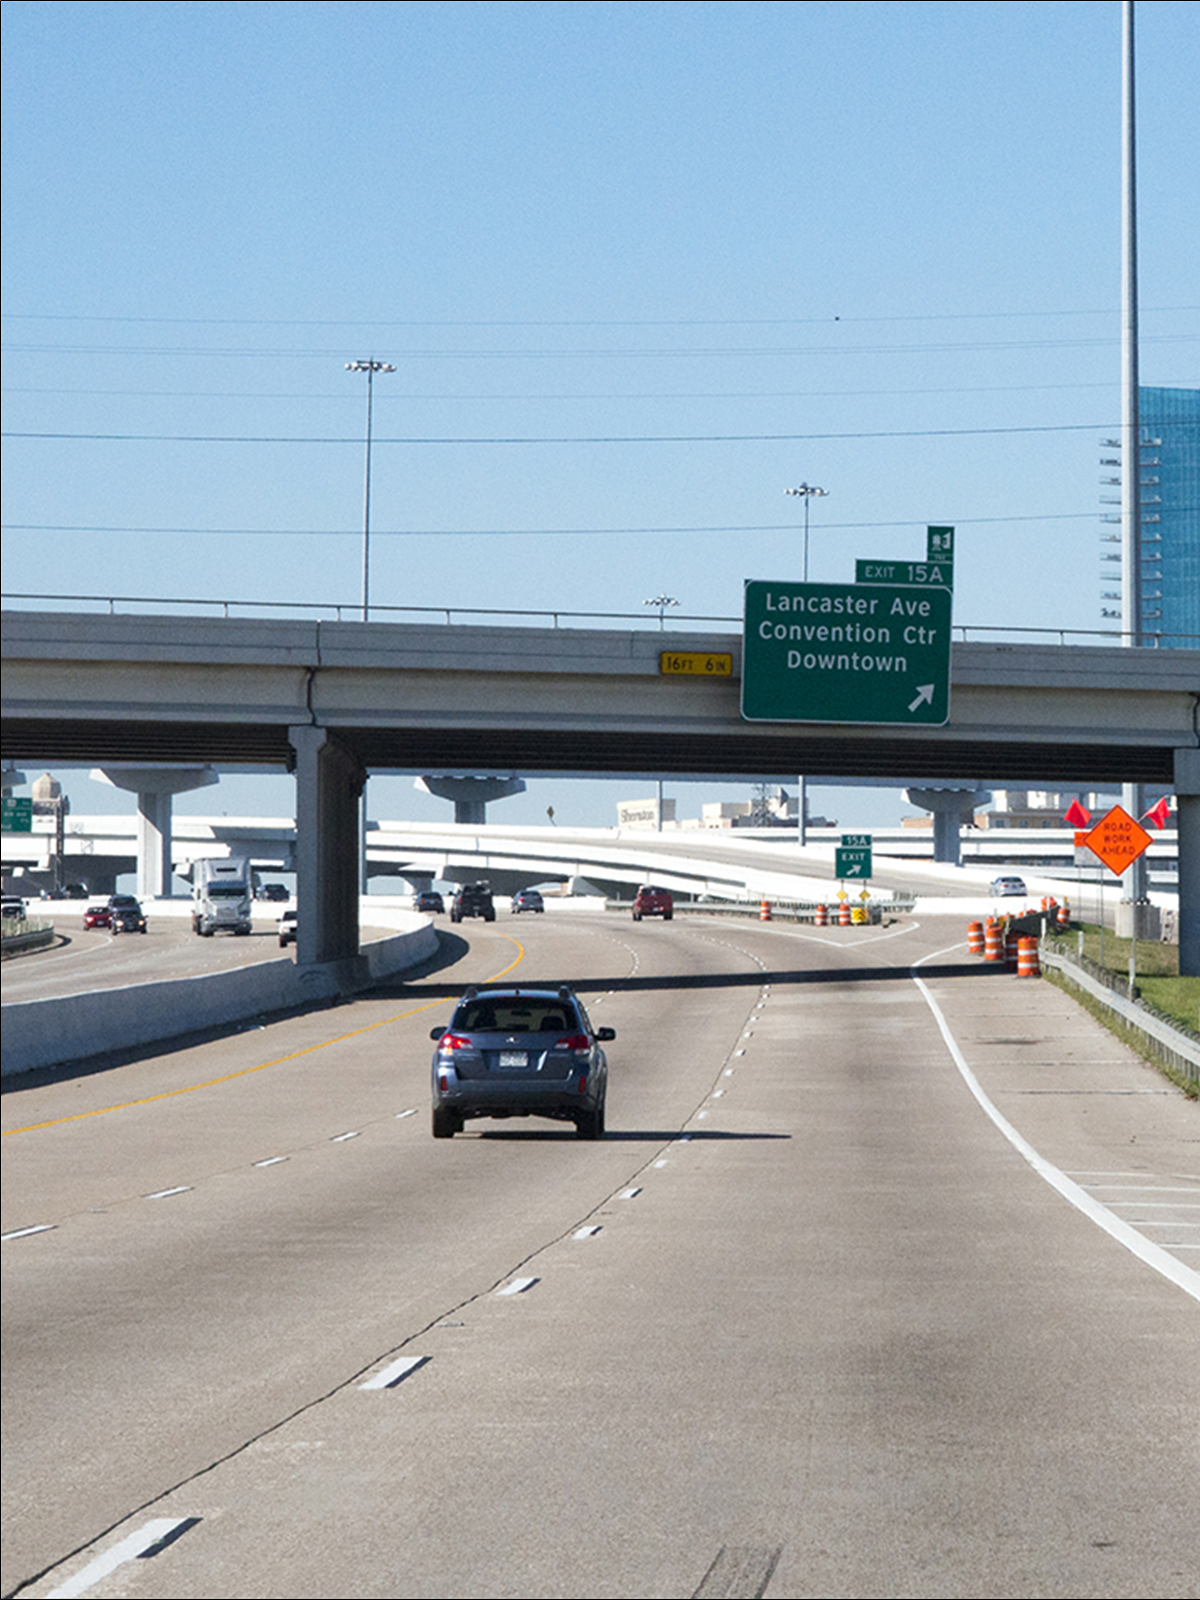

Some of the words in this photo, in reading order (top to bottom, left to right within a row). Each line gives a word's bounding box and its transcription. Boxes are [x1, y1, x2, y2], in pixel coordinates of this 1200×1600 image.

[865, 566, 895, 578] EXIT
[908, 565, 943, 582] 15A
[766, 593, 878, 614] Lancaster
[890, 597, 931, 617] Ave
[759, 620, 890, 643] Convention
[903, 626, 937, 645] Ctr
[787, 650, 908, 672] Downtown
[1103, 822, 1132, 832] ROAD
[846, 836, 868, 846] 15A
[1104, 835, 1132, 843] WORK
[1101, 846, 1135, 855] AHEAD
[841, 853, 865, 861] EXIT
